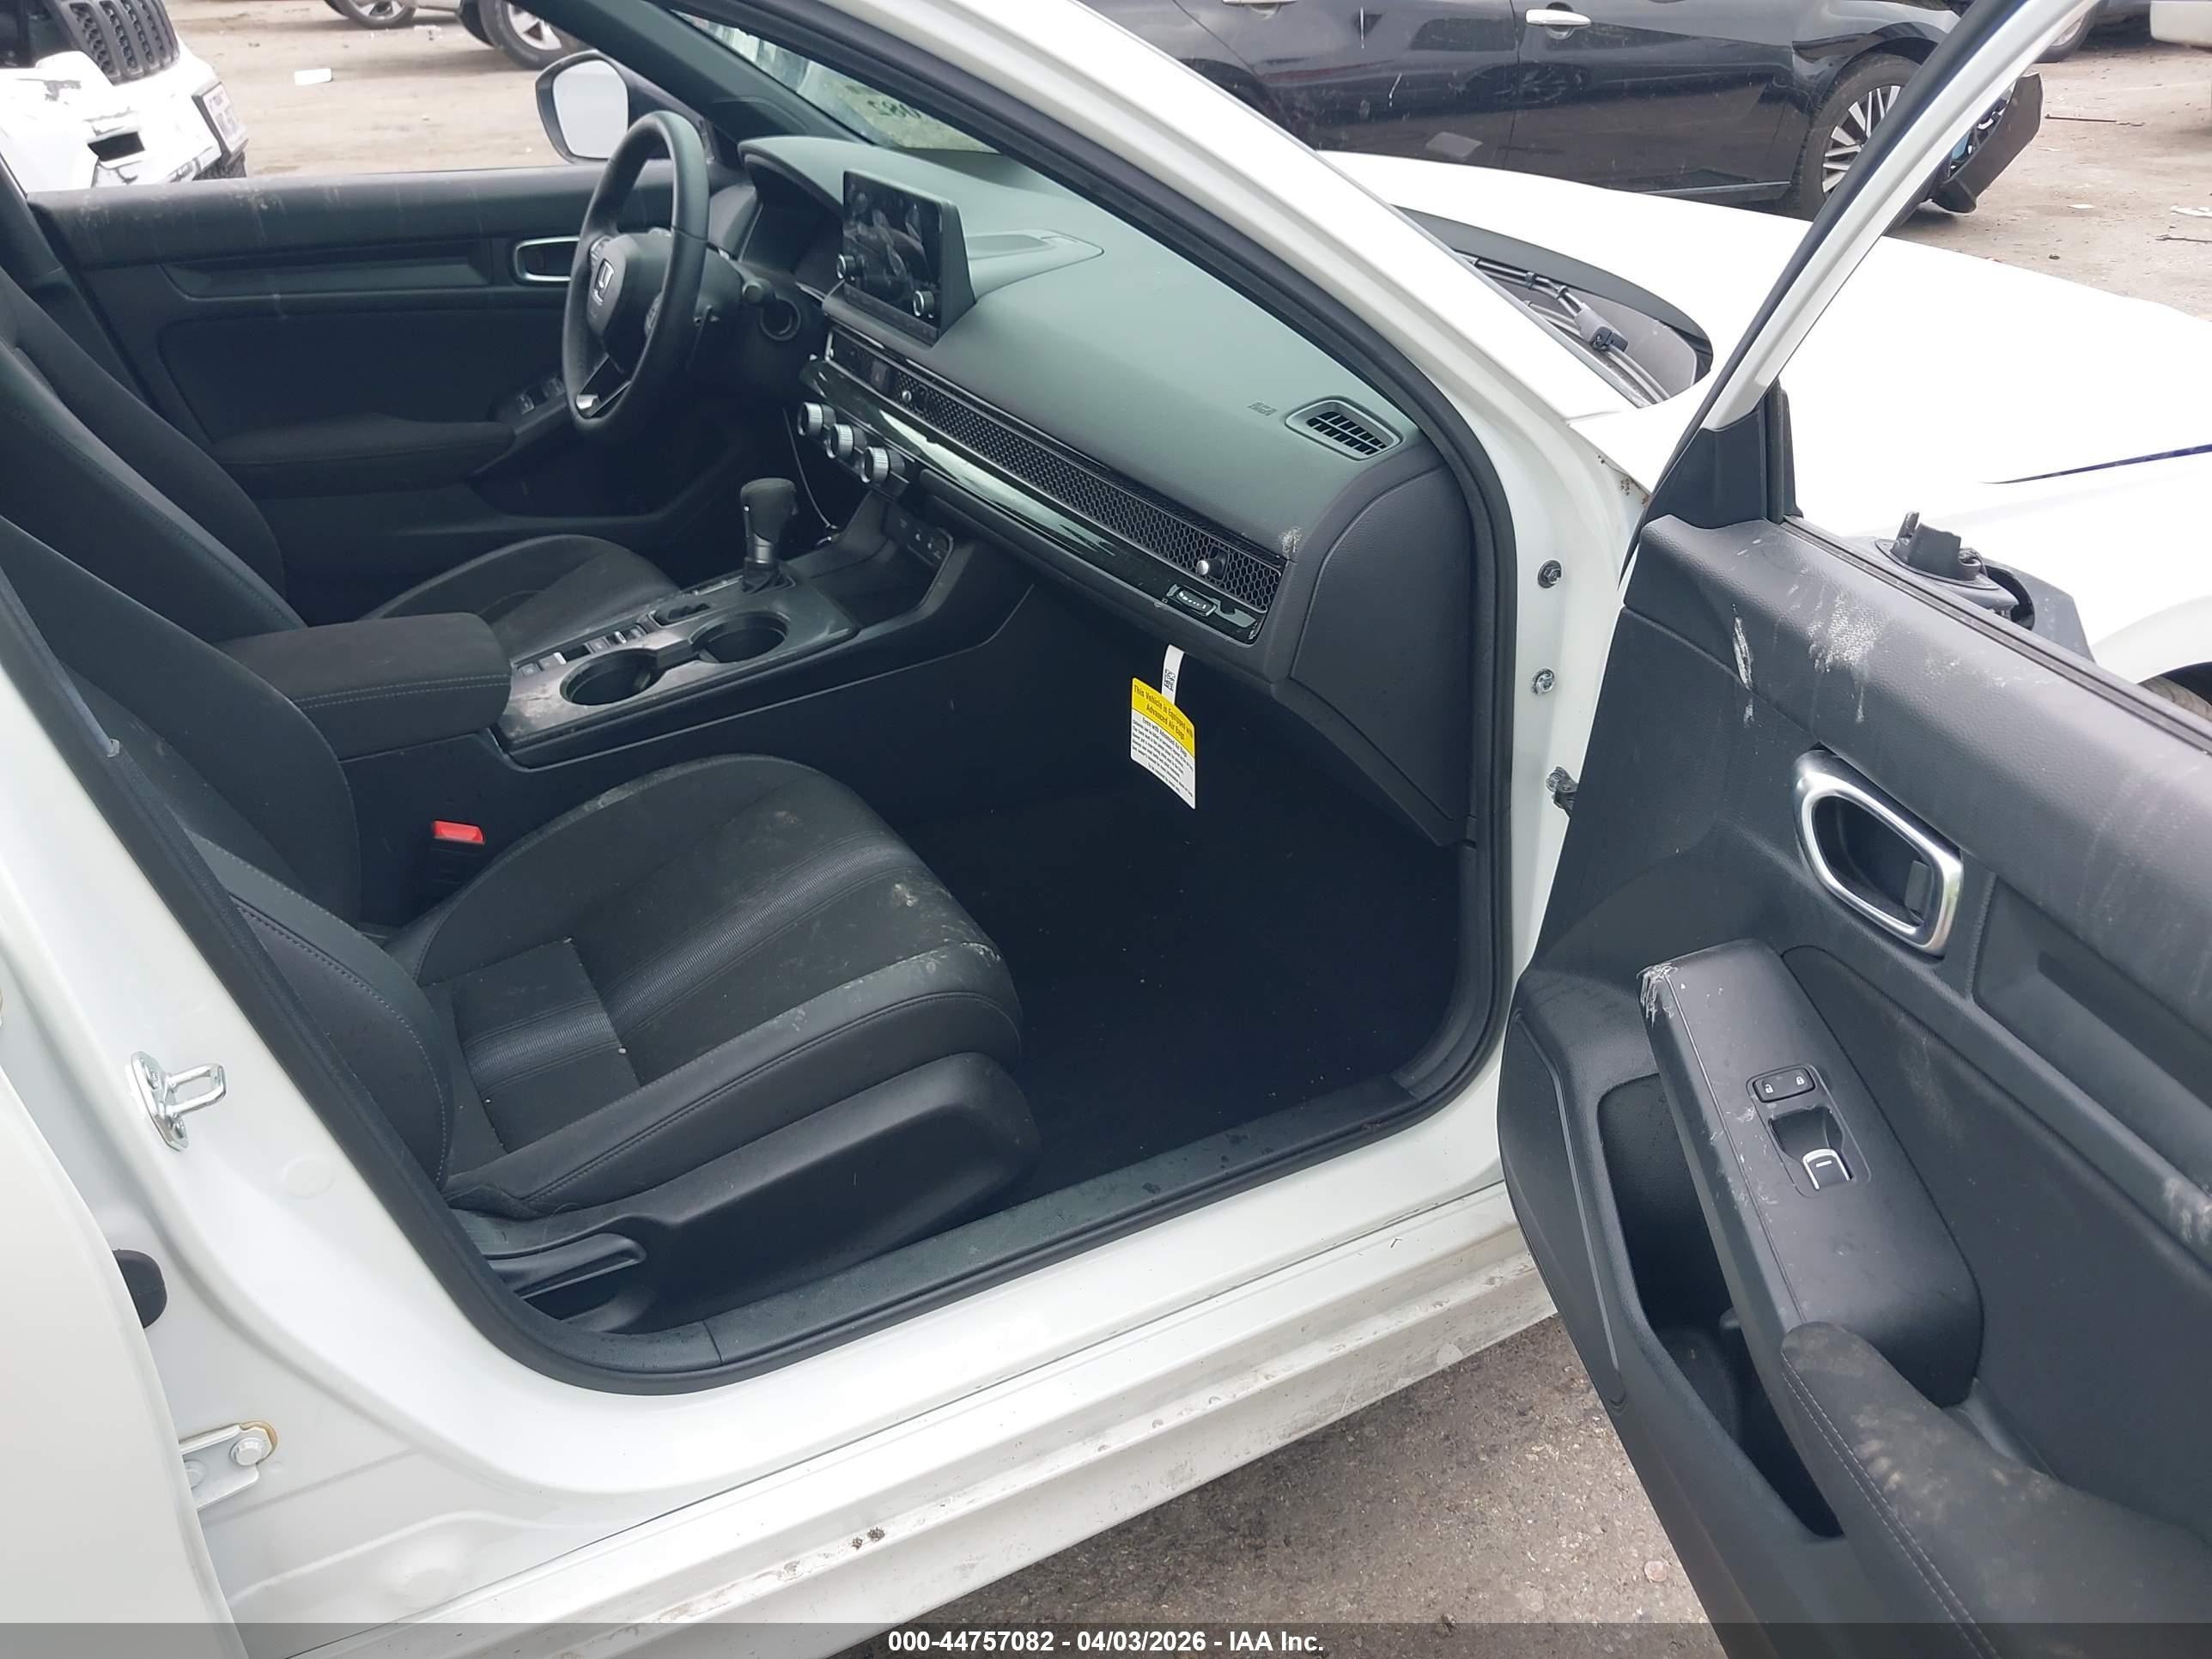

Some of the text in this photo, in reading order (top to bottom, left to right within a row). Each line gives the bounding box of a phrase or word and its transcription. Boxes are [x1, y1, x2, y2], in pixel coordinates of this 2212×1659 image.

[1133, 685, 1145, 698] This
[1146, 692, 1162, 709] Vehicle
[1146, 703, 1168, 725] Advanced
